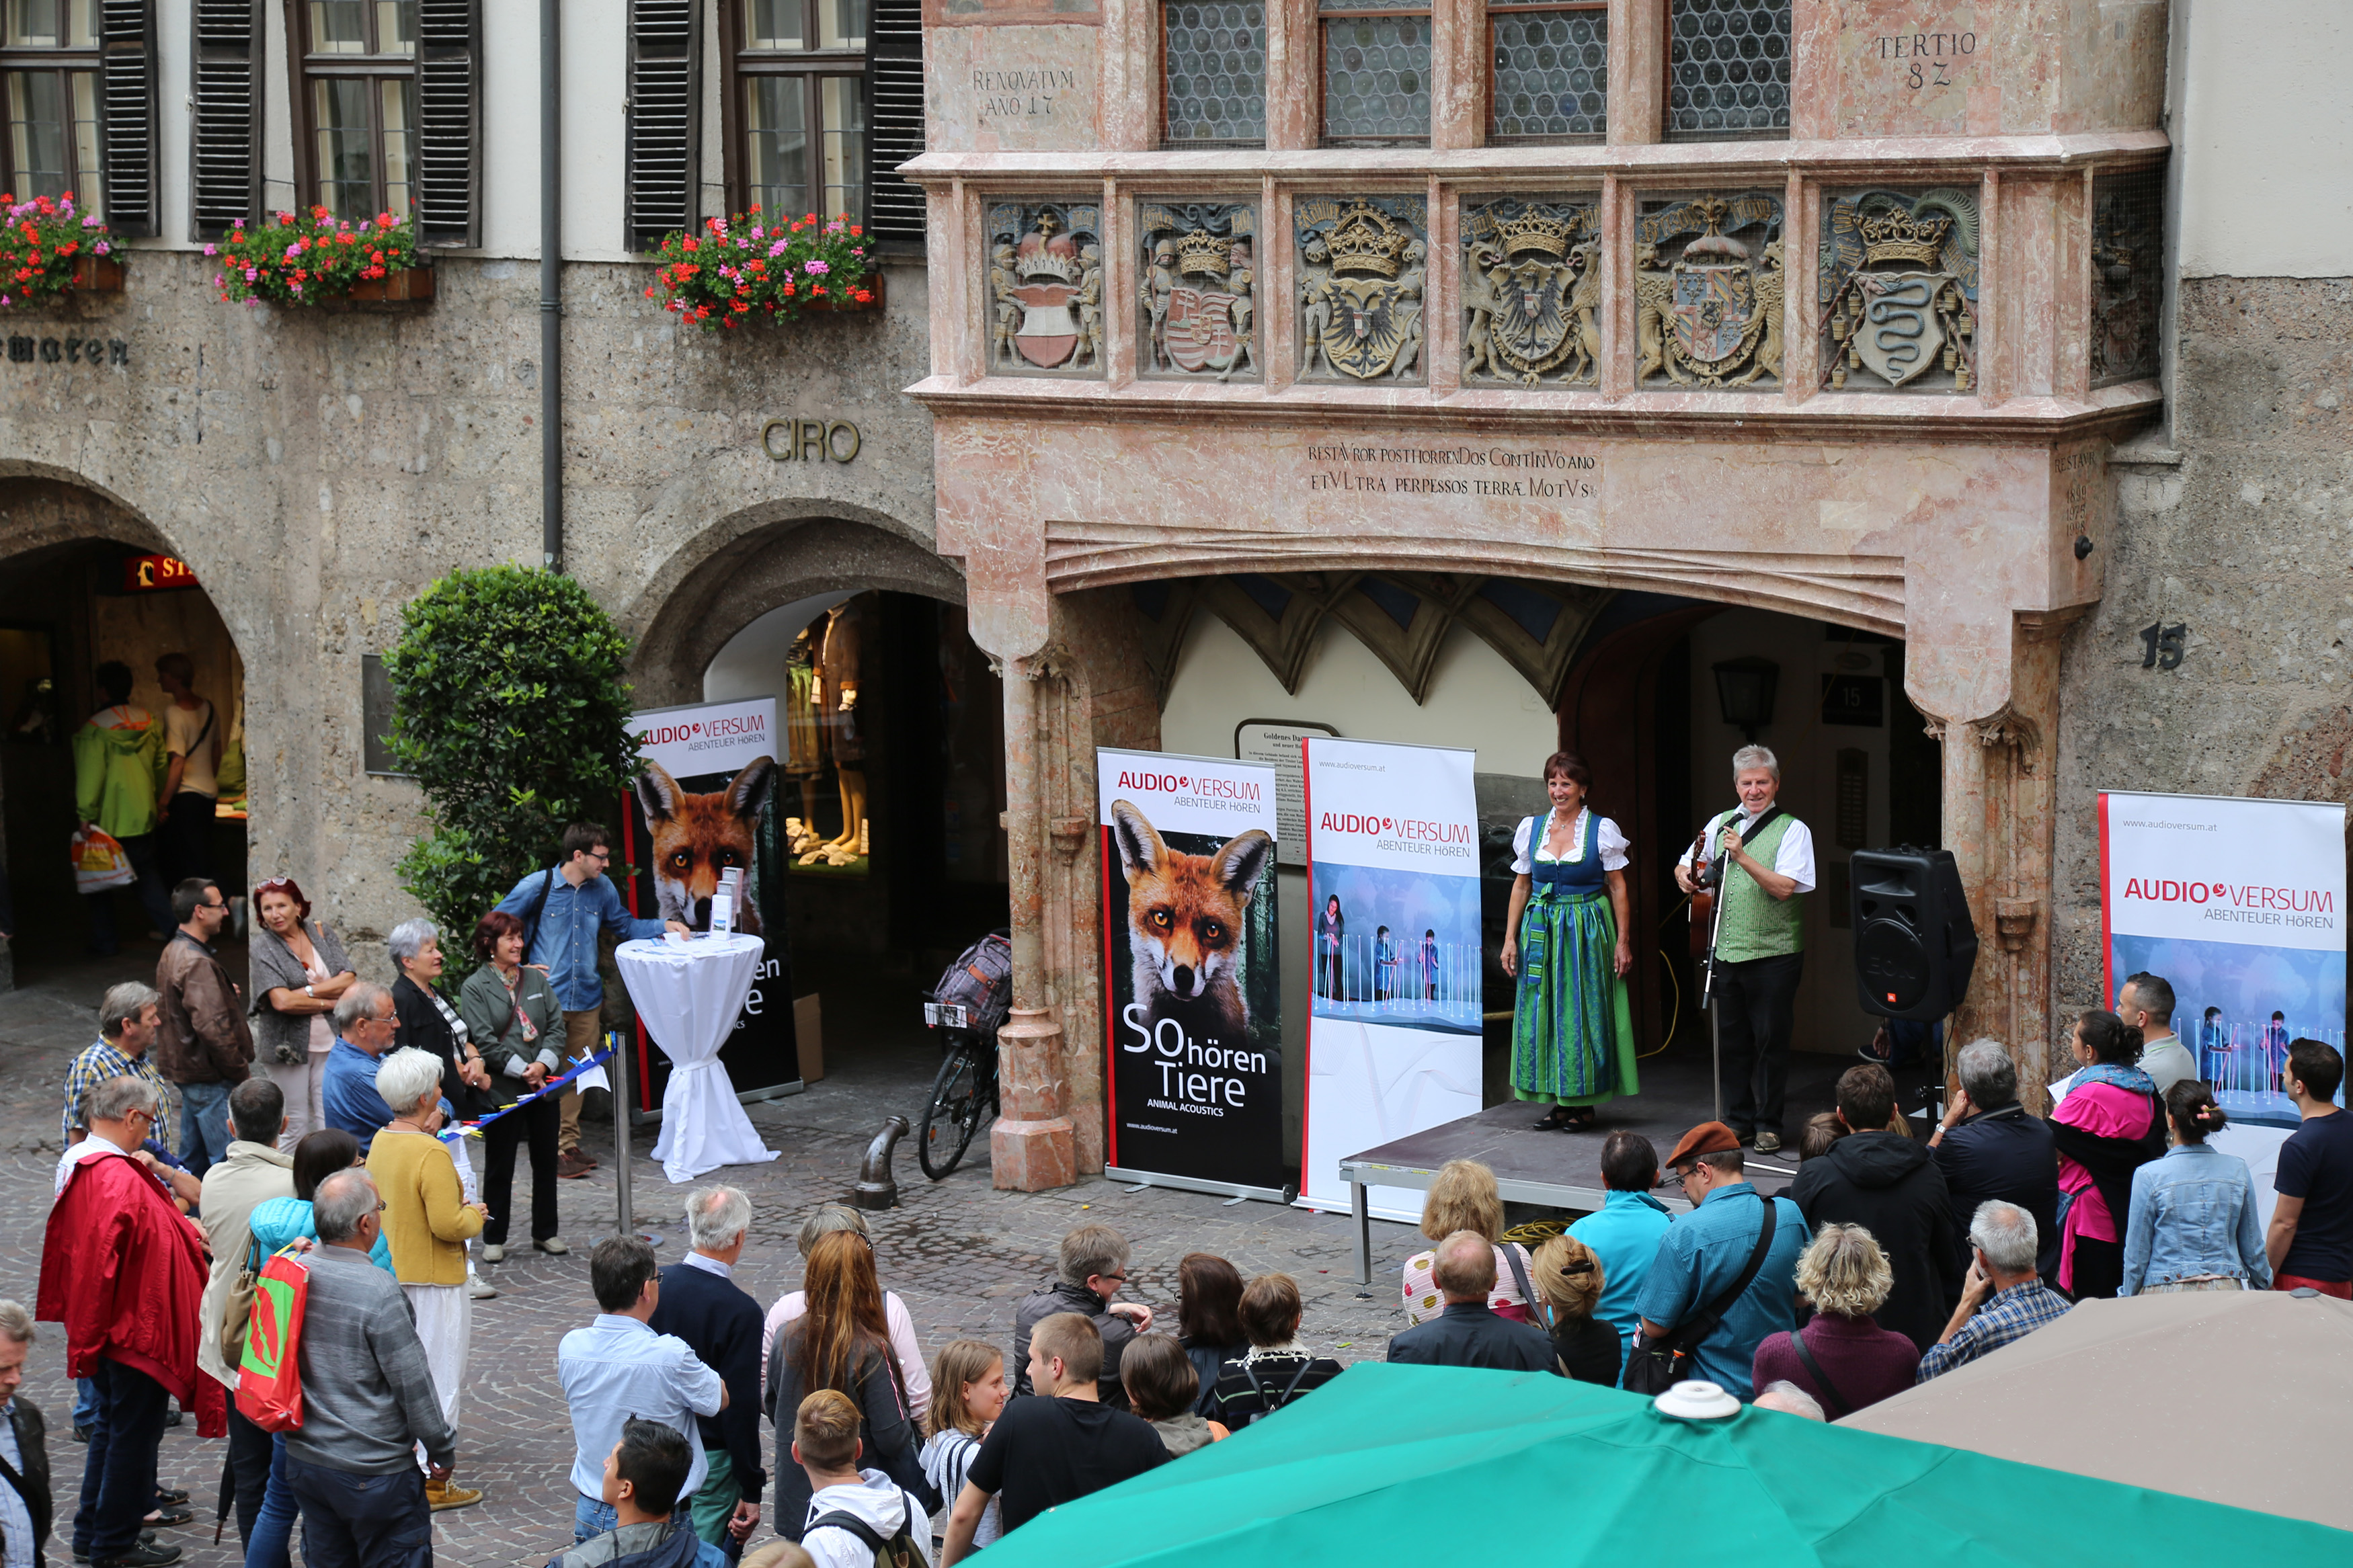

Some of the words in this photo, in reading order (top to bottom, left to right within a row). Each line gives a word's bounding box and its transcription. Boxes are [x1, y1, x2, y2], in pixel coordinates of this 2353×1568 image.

[1876, 33, 1975, 58] TERTIO
[973, 71, 1074, 91] RENOVATVM
[0, 330, 129, 365] waren
[760, 418, 861, 463] CIRO
[1396, 478, 1468, 495] PERPESSOS
[163, 557, 194, 577] ST
[2140, 621, 2186, 669] 15
[1843, 687, 1860, 707] 15
[702, 714, 764, 738] VERSUM
[688, 737, 735, 752] ABENTEUER
[1264, 732, 1291, 741] Goldenes
[1319, 760, 1386, 772] www.audioversum.at
[1117, 771, 1178, 793] AUDIO
[1191, 777, 1261, 801] VERSUM
[1174, 796, 1227, 811] ABENTEUER
[1320, 812, 1380, 835] AUDIO
[1394, 819, 1470, 844] VERSUM
[2122, 819, 2217, 832] www.audioversum.at
[1376, 839, 1431, 855] ABENTEUER
[2124, 878, 2209, 904] AUDIO
[2229, 884, 2334, 913] VERSUM
[2204, 908, 2281, 925] ABENTEUER
[1187, 1037, 1267, 1074] hören
[1154, 1060, 1246, 1108] Tiere
[1147, 1098, 1178, 1111] ANIMAL
[1179, 1103, 1224, 1117] ACOUSTICS
[1126, 1122, 1177, 1134] www.audioversum.at
